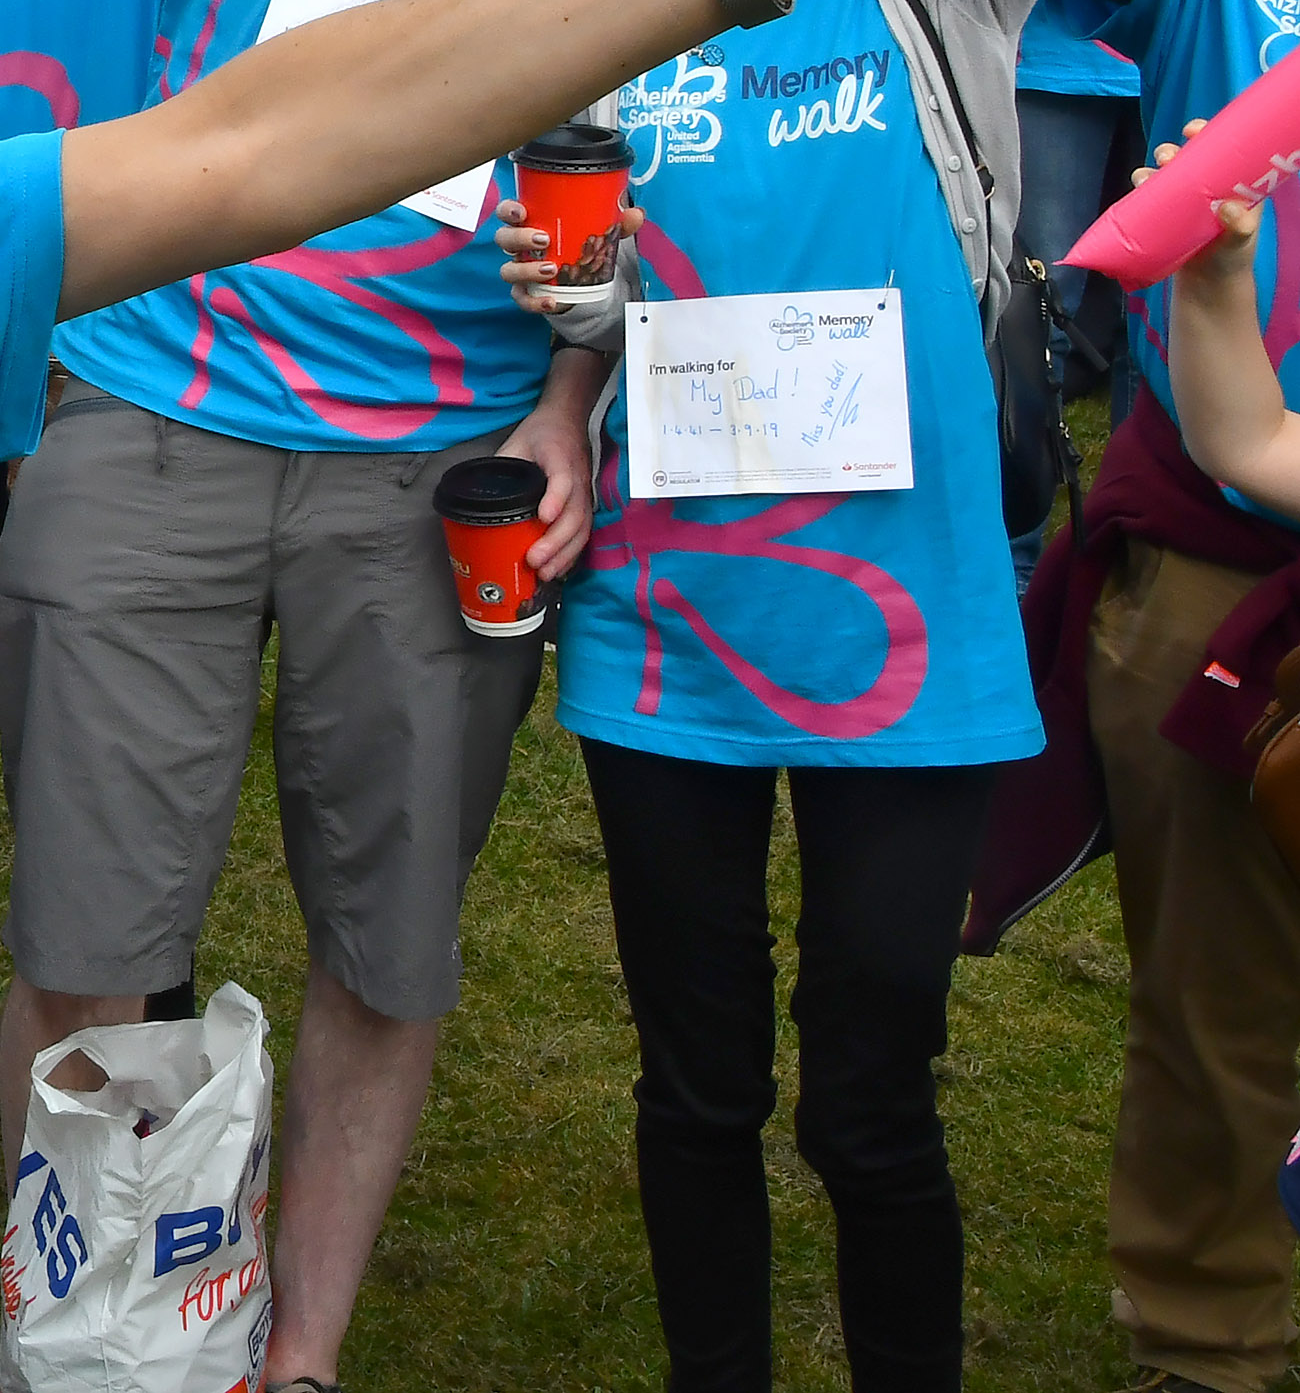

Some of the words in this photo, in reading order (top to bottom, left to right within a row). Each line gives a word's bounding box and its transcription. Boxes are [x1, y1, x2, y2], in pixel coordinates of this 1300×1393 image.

[741, 50, 890, 100] Memory
[768, 70, 887, 147] walk
[628, 108, 702, 130] Society
[667, 131, 700, 141] United
[667, 152, 715, 164] Dementia
[818, 314, 874, 327] Memory
[828, 320, 870, 340] walk
[649, 363, 667, 376] I'm
[668, 361, 715, 376] walking
[717, 359, 736, 371] for
[690, 379, 723, 415] My
[733, 369, 779, 401] Dad
[800, 423, 823, 448] Miss
[821, 389, 835, 419] you
[853, 461, 897, 472] Santander
